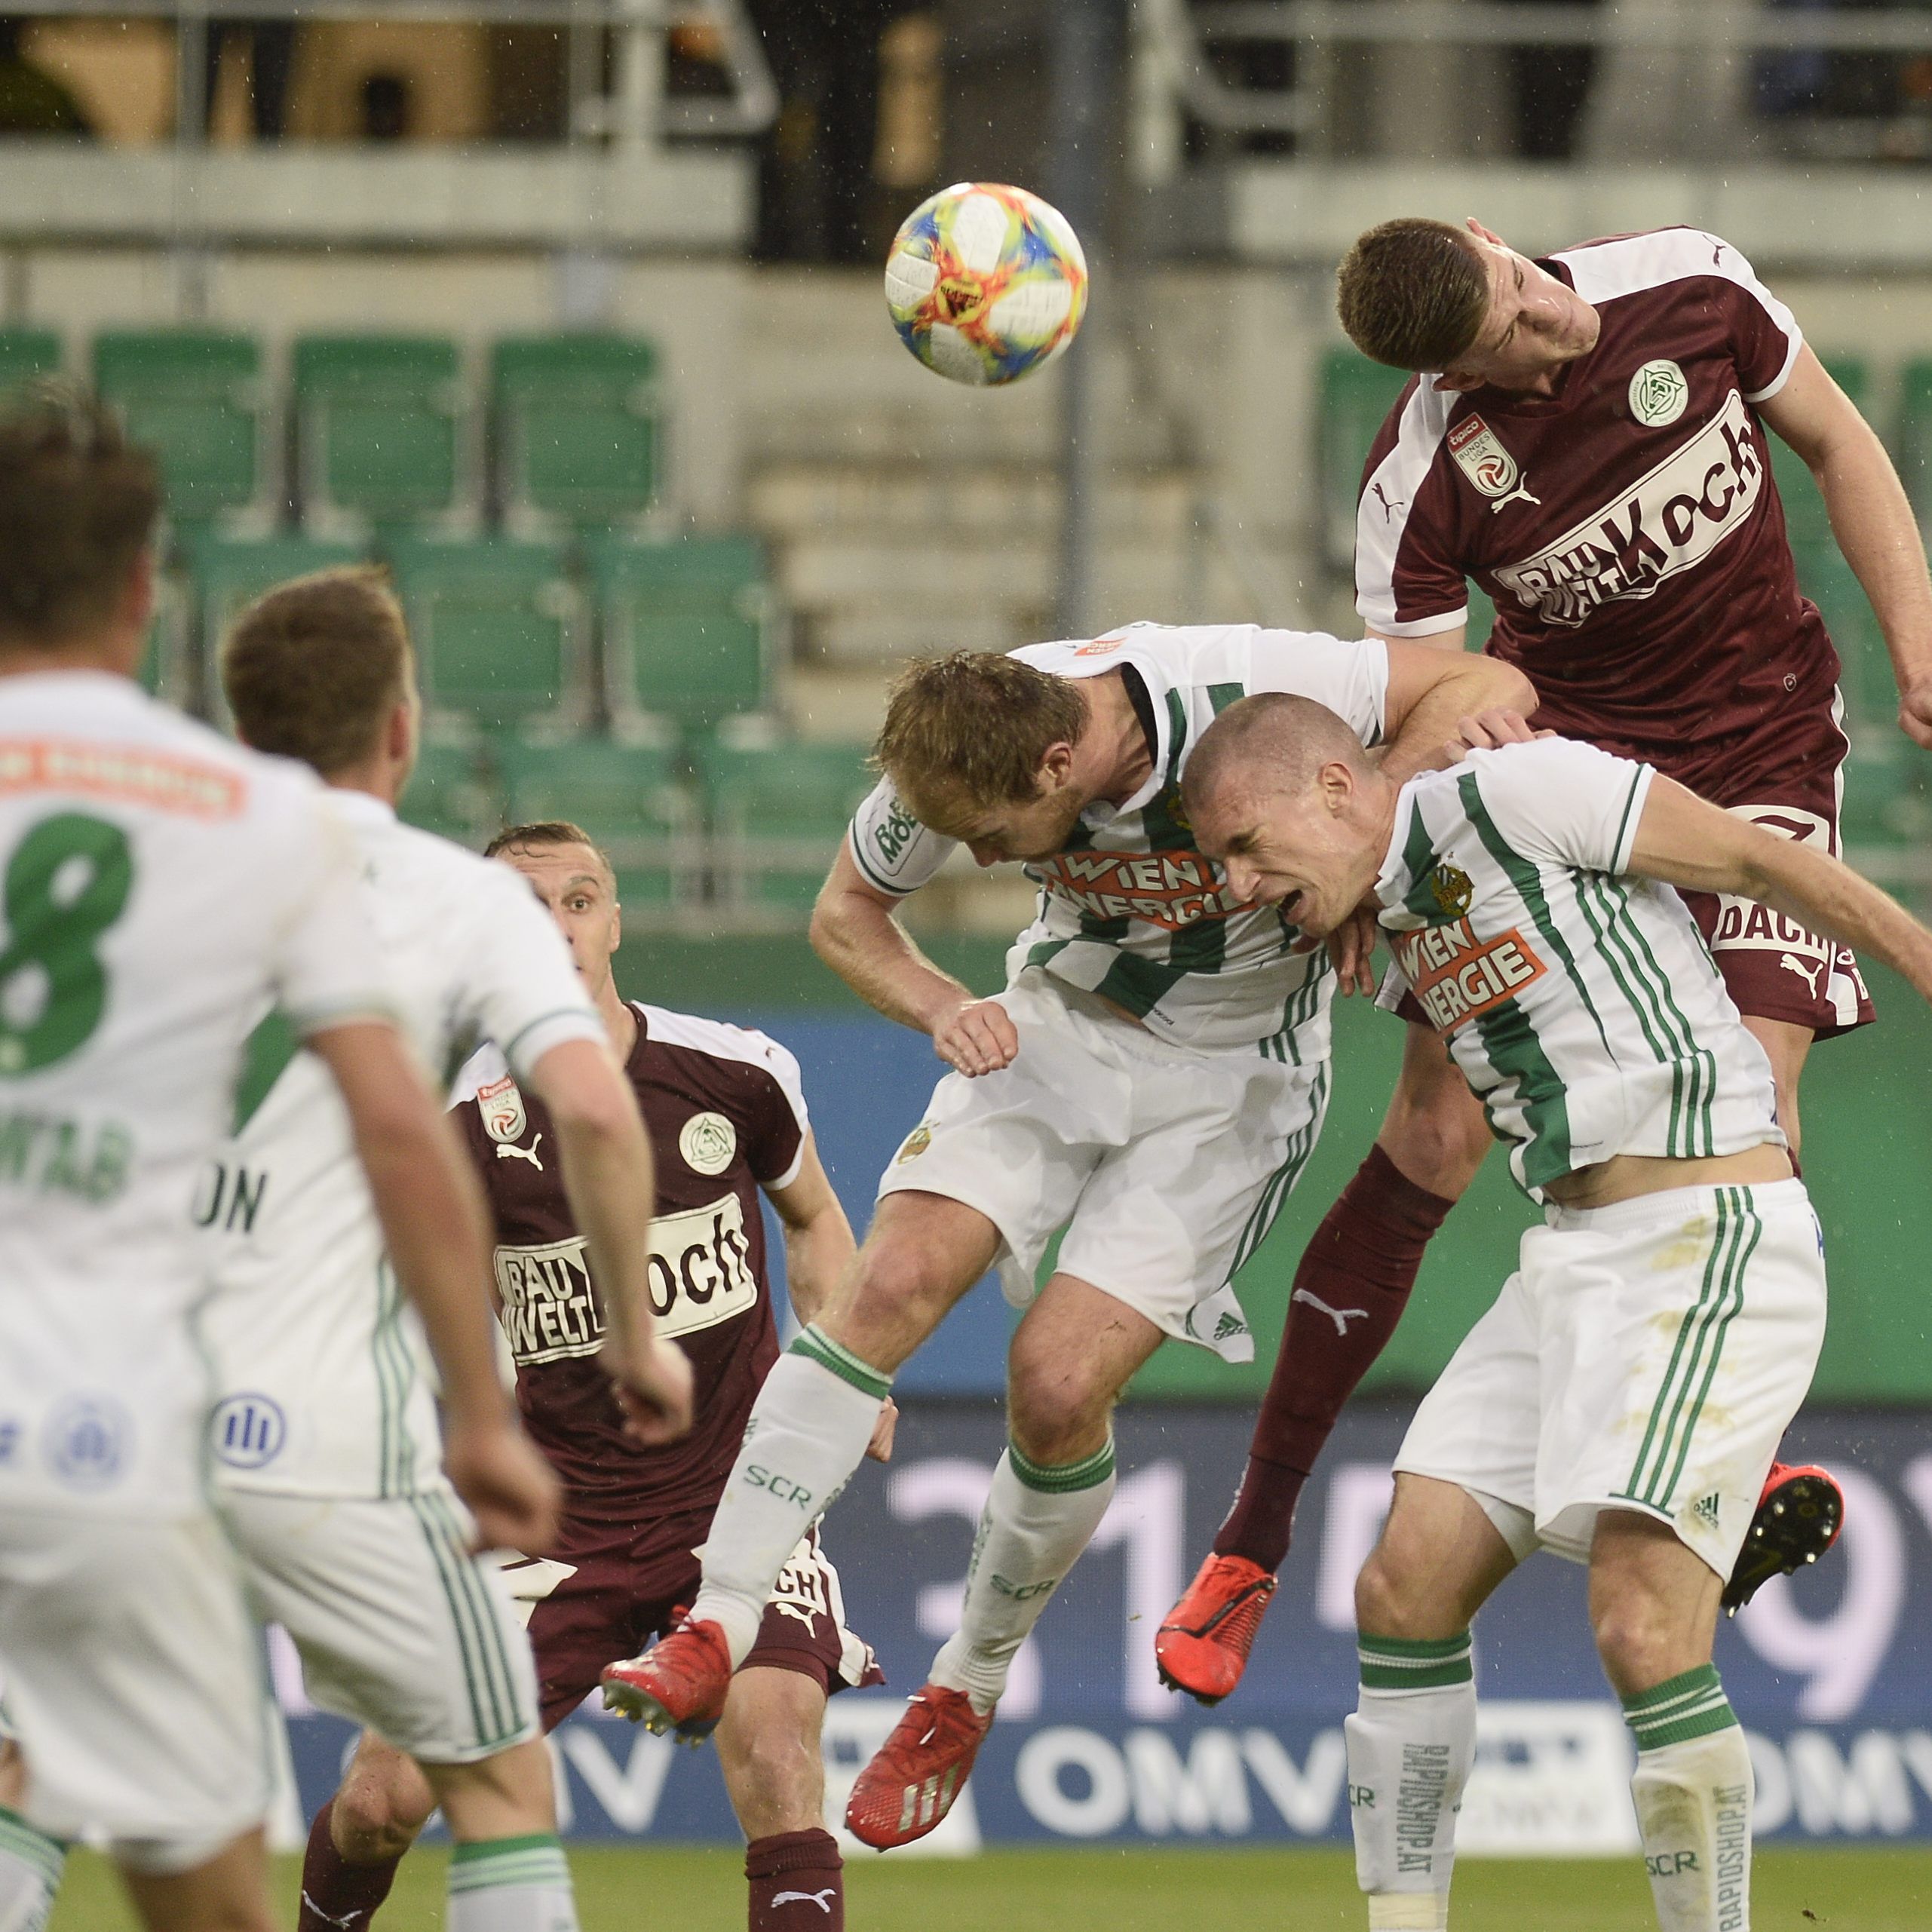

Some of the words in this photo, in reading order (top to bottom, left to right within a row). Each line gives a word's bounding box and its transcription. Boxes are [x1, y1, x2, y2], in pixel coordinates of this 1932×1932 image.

[1457, 433, 1490, 461] BUNDES
[1468, 446, 1489, 462] LIGA
[1064, 855, 1202, 891] WIEN
[0, 808, 136, 1080] 8
[1400, 919, 1473, 983] WIEN
[1418, 941, 1536, 1033] NERGIE
[507, 1256, 574, 1307] BAU
[507, 1296, 590, 1353] WELT
[743, 1464, 813, 1510] SCR
[774, 1567, 817, 1602] CH
[1015, 1725, 1348, 1837] OMV
[1348, 1783, 1375, 1809] CR
[1397, 1742, 1450, 1873] RAPIDSHOP.AT
[1644, 1850, 1700, 1877] SCR
[1712, 1783, 1746, 1932] RAPIDSHOP.AT
